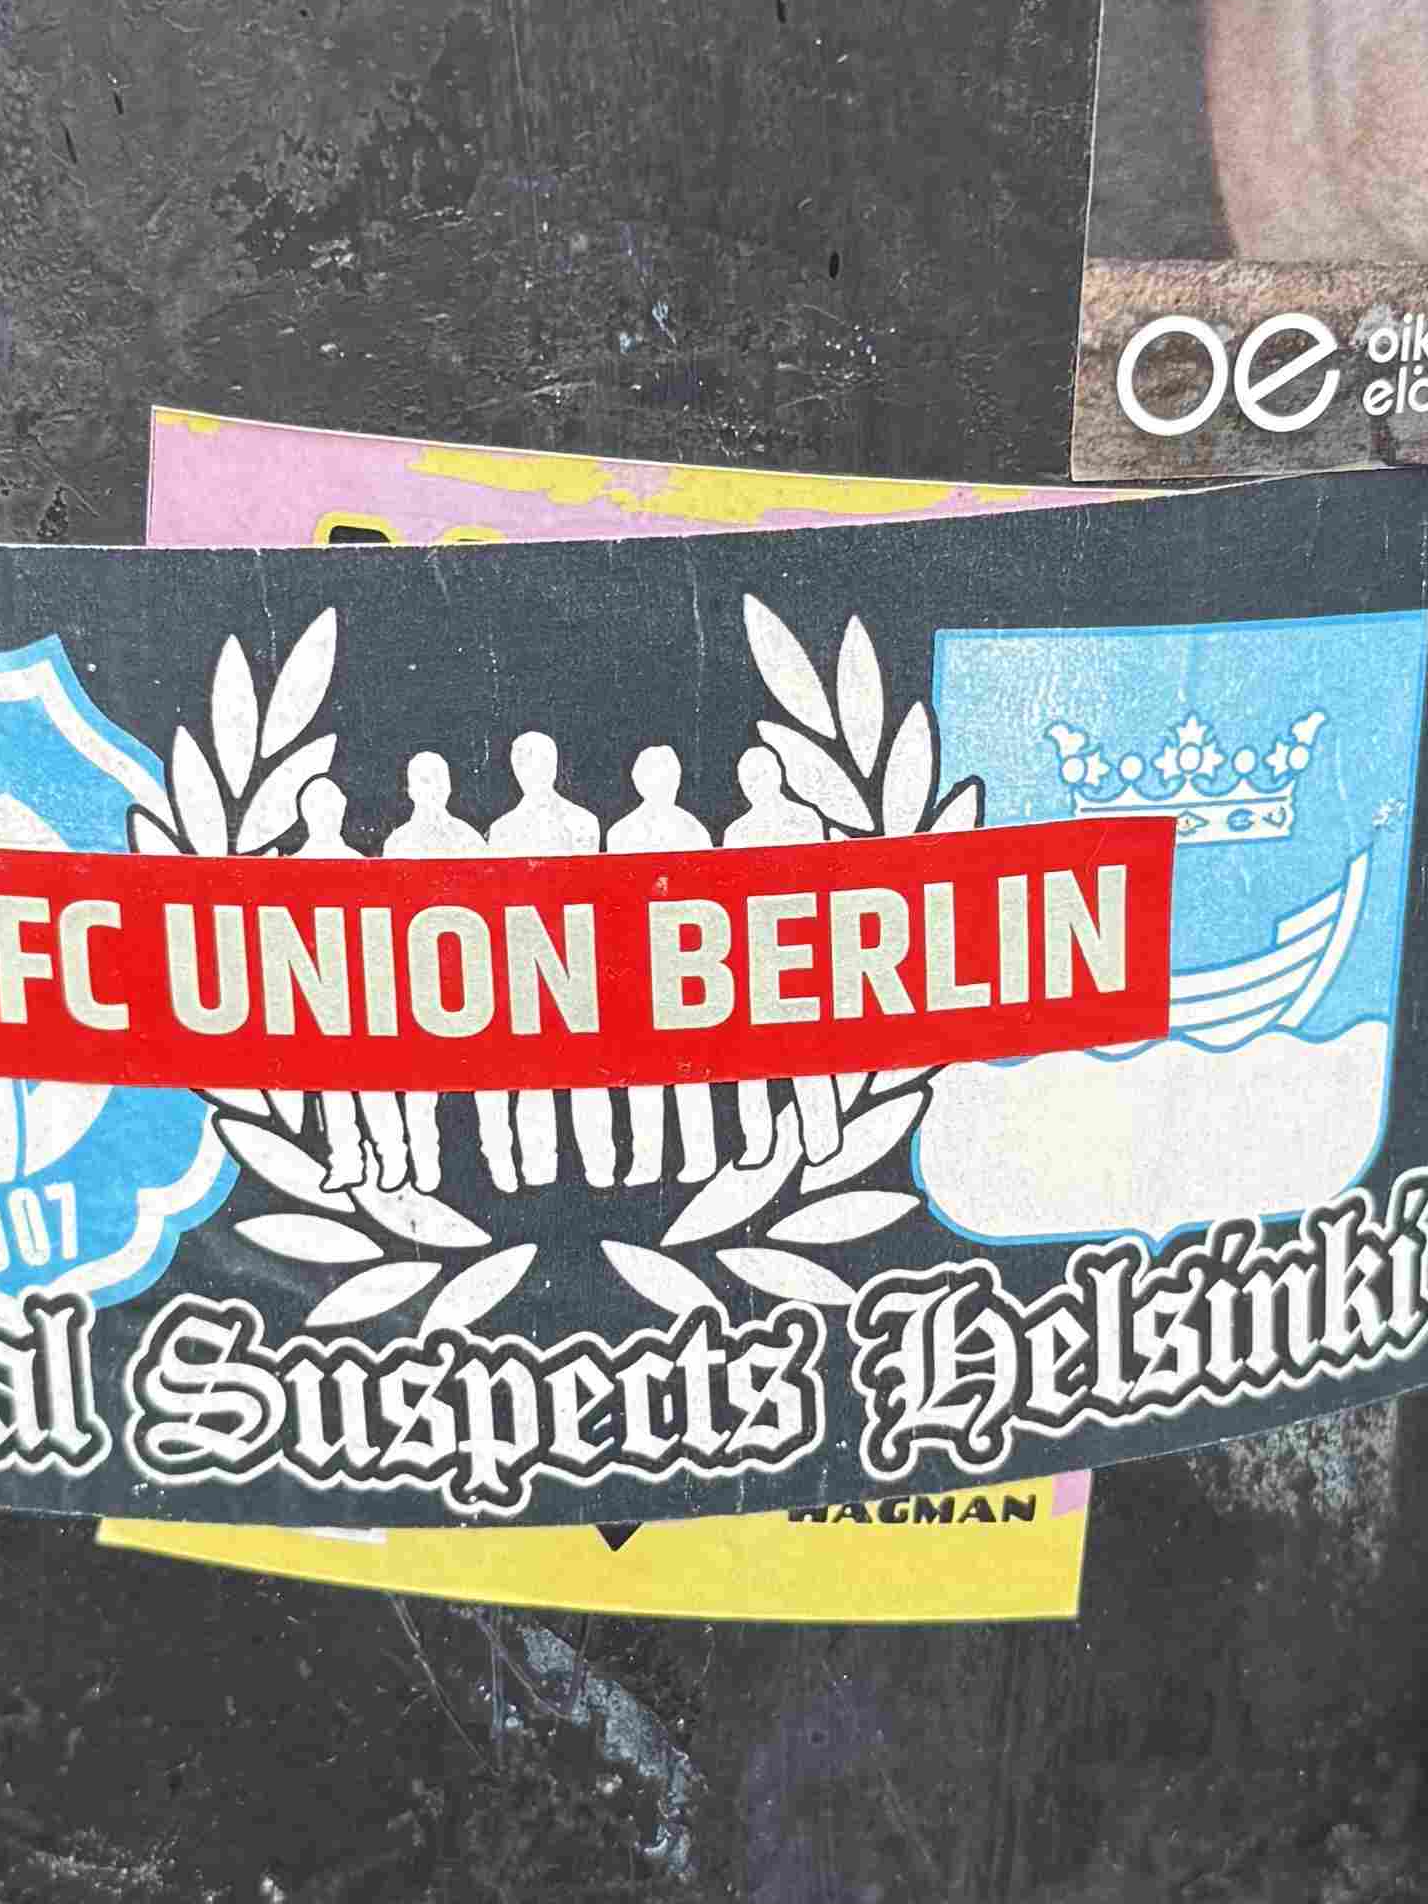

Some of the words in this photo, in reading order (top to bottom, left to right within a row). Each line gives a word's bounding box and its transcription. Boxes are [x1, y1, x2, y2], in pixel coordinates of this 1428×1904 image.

[161, 899, 604, 1038] UNION
[646, 863, 1129, 1032] BERLIN
[137, 1304, 815, 1502] Suspects
